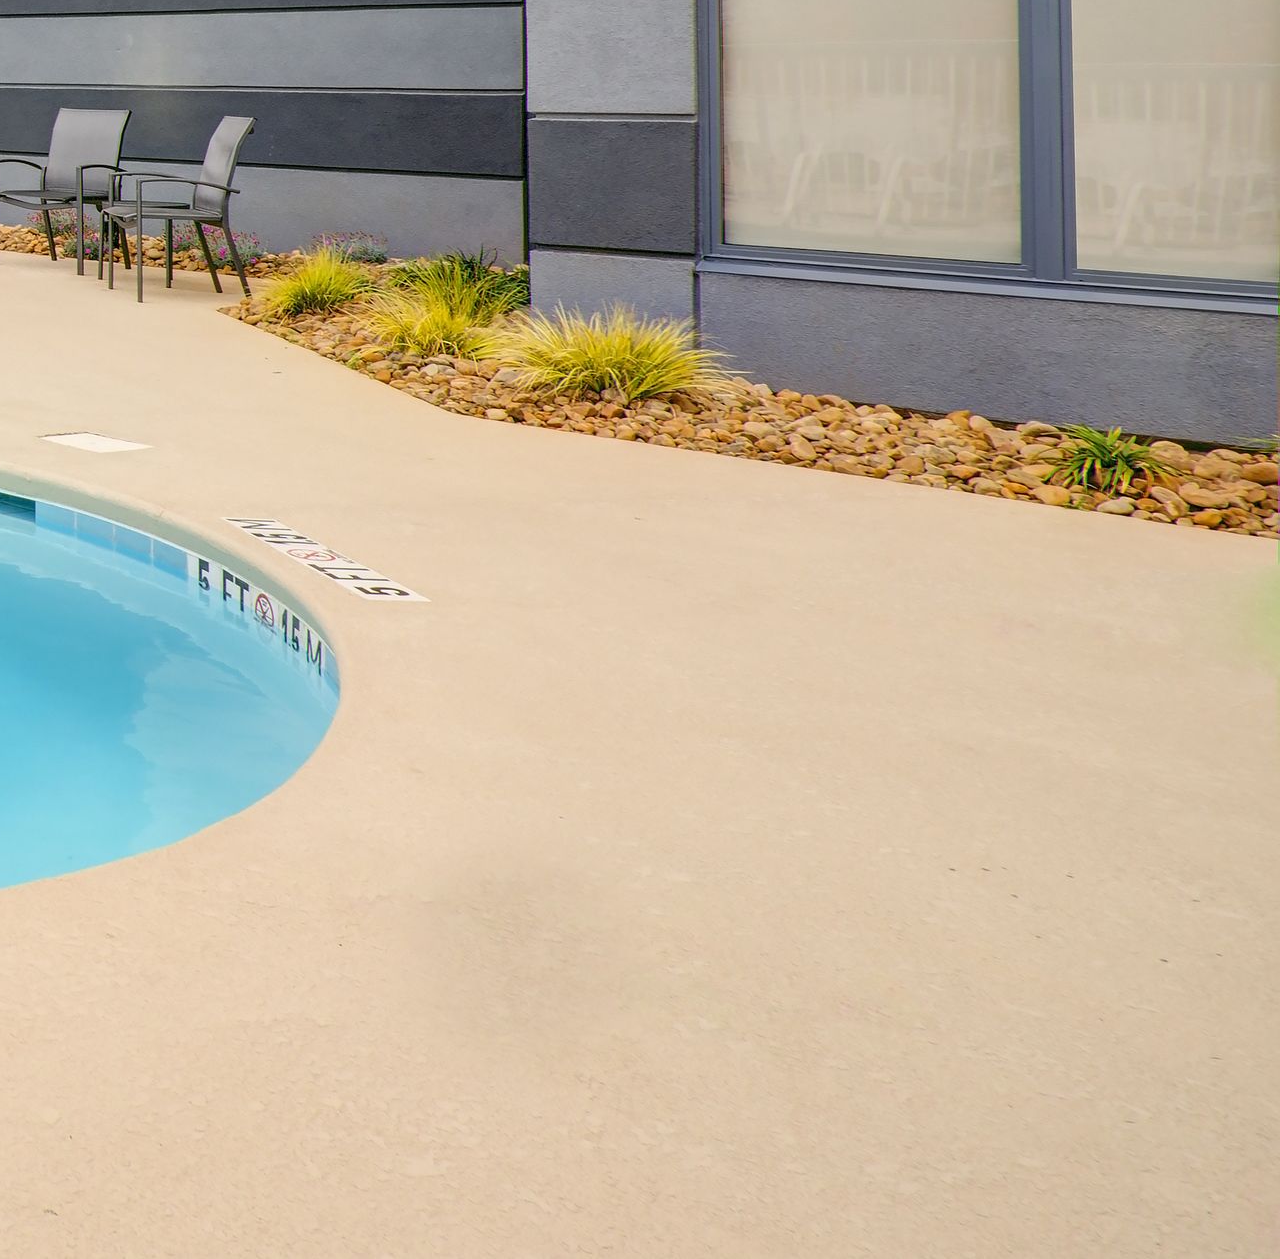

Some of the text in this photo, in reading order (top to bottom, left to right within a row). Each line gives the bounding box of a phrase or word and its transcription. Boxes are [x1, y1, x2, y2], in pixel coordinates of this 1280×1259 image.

[198, 558, 210, 592] 5
[222, 569, 250, 613] FT
[306, 628, 322, 677] M
